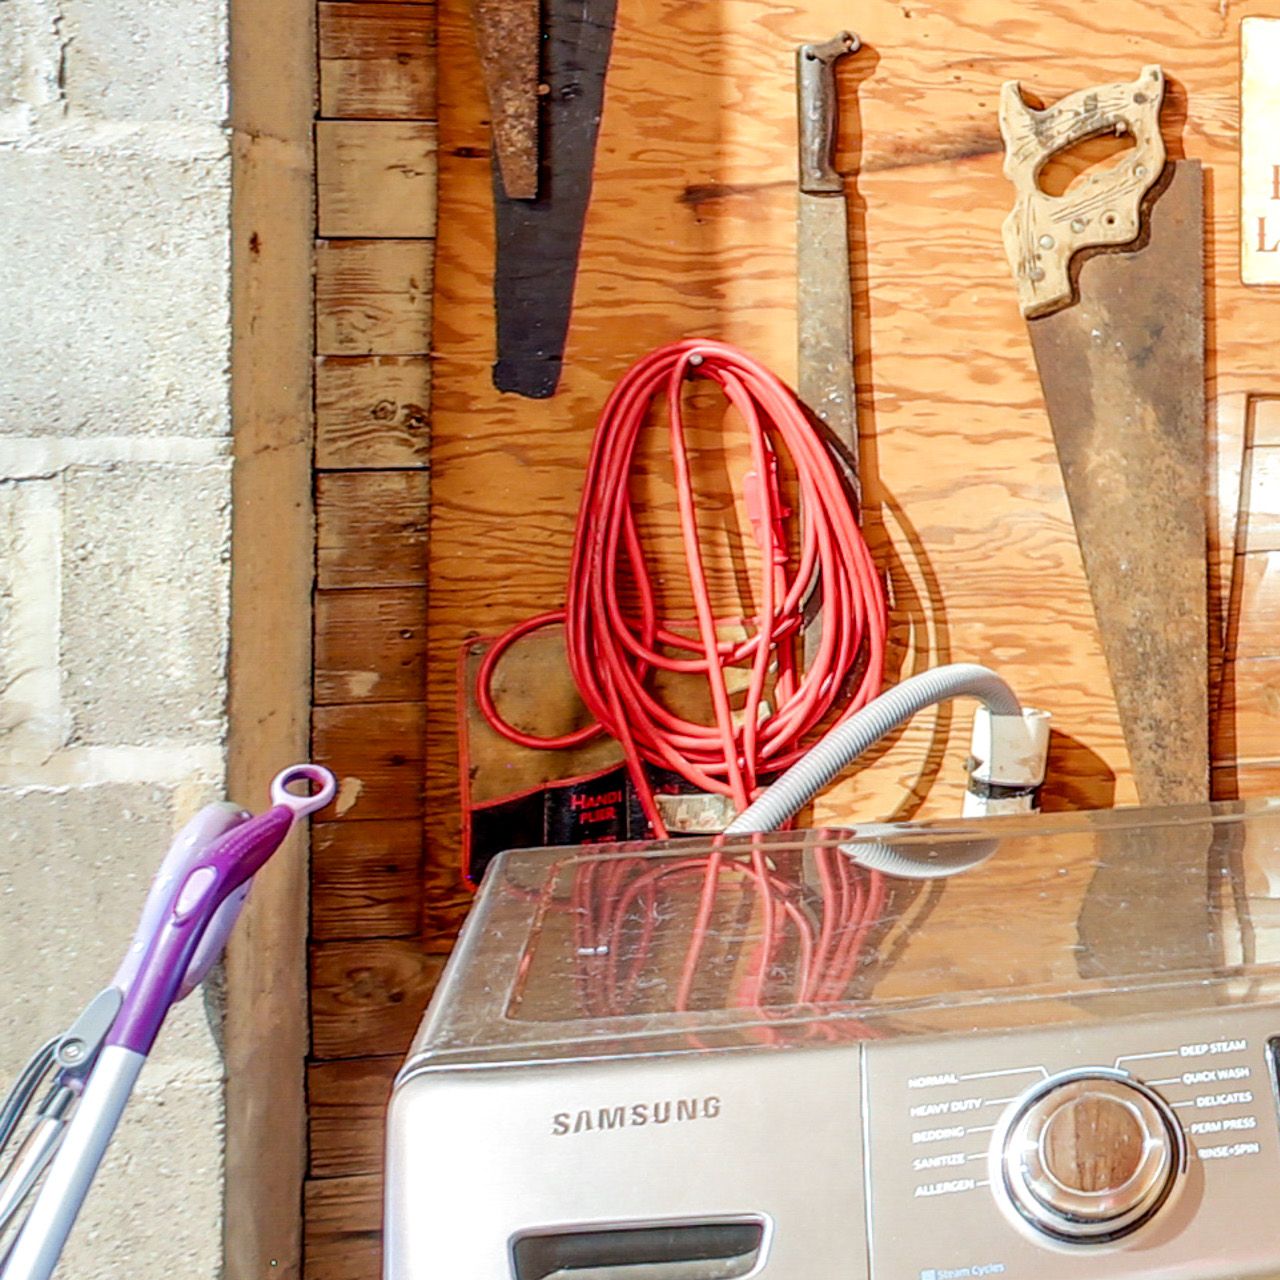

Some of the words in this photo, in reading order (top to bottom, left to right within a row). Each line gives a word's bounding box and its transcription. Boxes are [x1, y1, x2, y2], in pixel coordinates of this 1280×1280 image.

[1180, 1044, 1209, 1057] DEEP
[1209, 1040, 1247, 1054] STEAM
[908, 1073, 959, 1088] NORMAL
[1182, 1071, 1217, 1085] QUICK
[1216, 1067, 1250, 1081] WASH
[910, 1103, 949, 1117] HEAVY
[951, 1098, 982, 1112] DUTY
[1196, 1091, 1253, 1107] DELICATES
[552, 1095, 721, 1137] SAMSUNG
[1191, 1121, 1222, 1134] PERM
[1222, 1116, 1256, 1130] PRESS
[912, 1126, 965, 1143] BEDDING
[912, 1153, 965, 1170] SANITIZE
[914, 1179, 976, 1197] ALLERGEN
[936, 1268, 971, 1280] Steam
[971, 1263, 1006, 1278] Cycles
